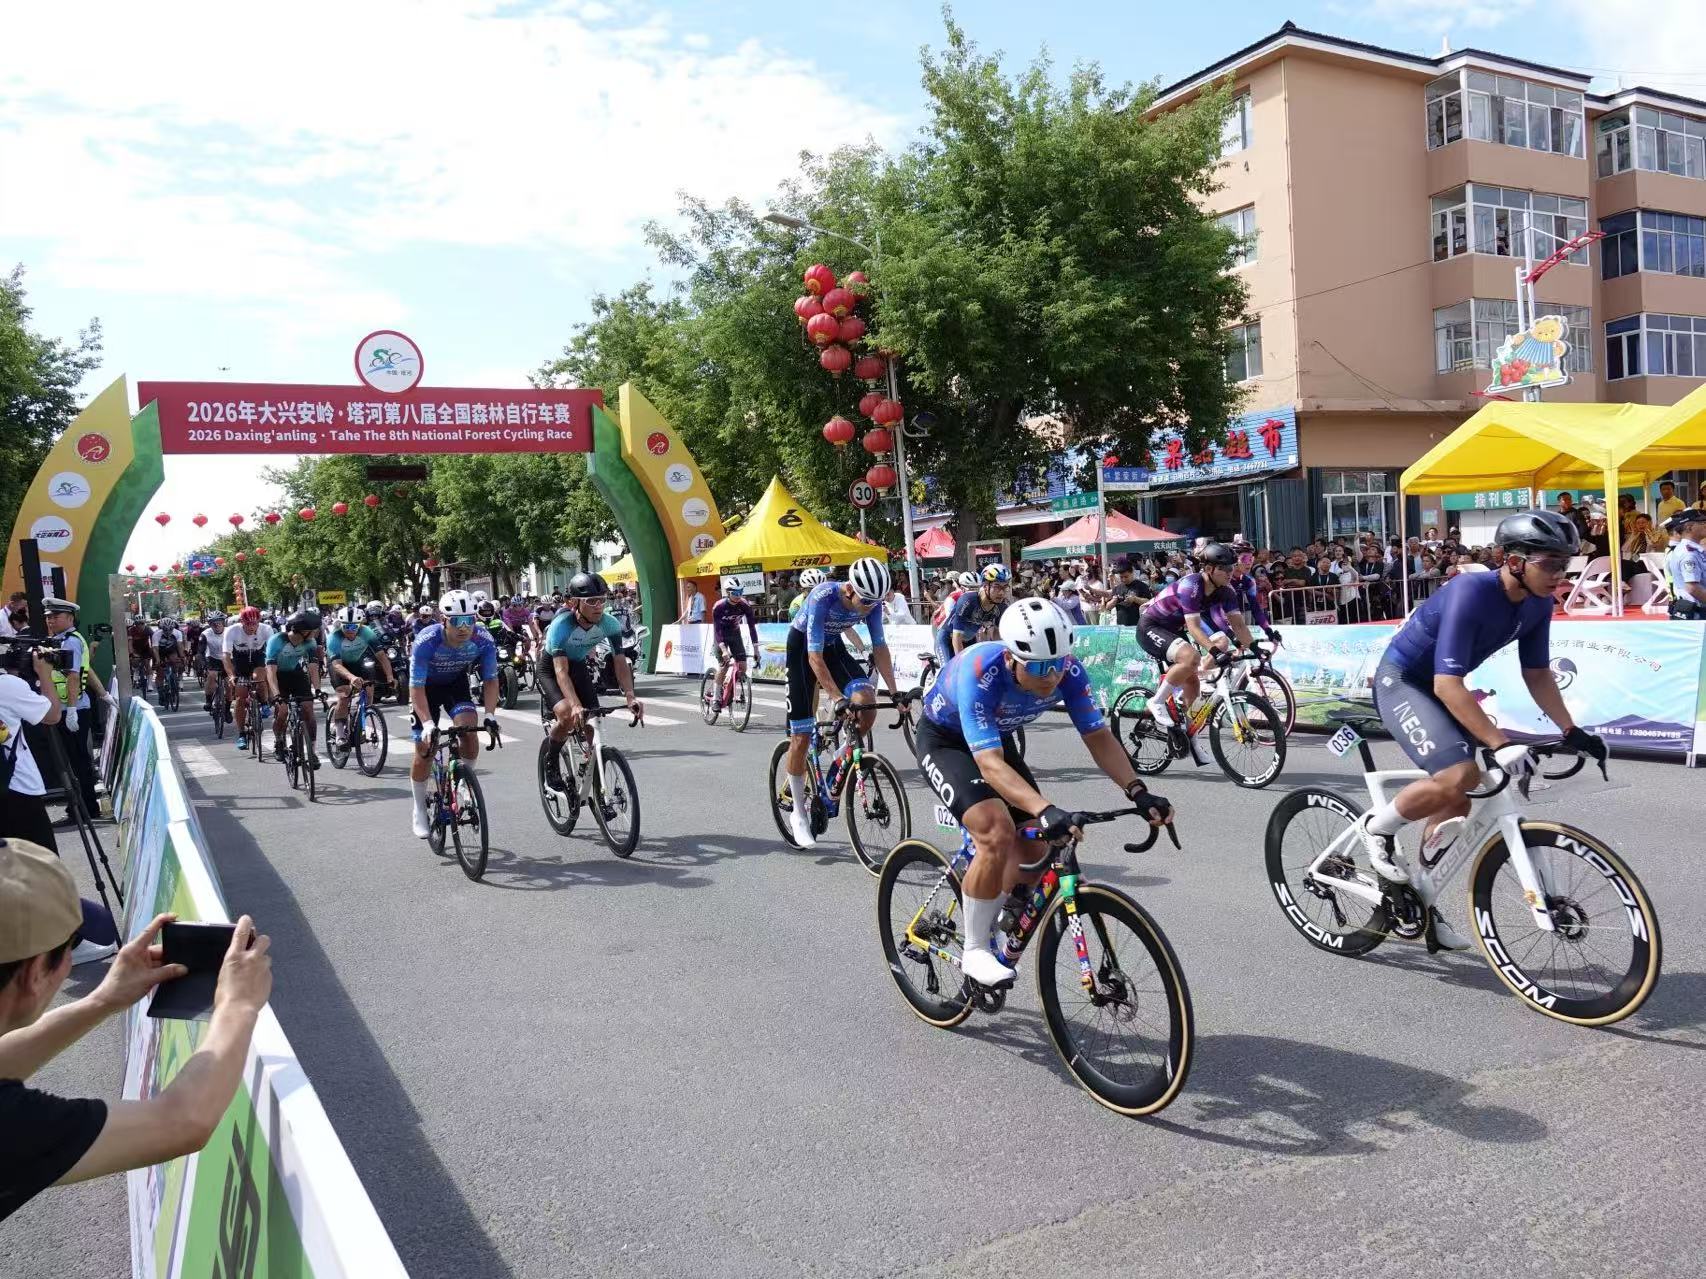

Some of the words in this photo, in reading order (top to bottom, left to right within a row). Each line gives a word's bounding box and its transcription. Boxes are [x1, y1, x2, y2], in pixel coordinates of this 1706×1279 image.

[187, 401, 571, 425] 2026年大兴安岭·塔河第八届全国森林自行车赛
[188, 429, 222, 441] 2026
[224, 429, 317, 444] Daxing'anling
[329, 430, 361, 441] Tahe
[363, 430, 386, 441] The
[389, 430, 410, 441] 8th
[412, 429, 462, 441] National
[465, 429, 501, 440] Forest
[503, 429, 545, 442] Cycling
[546, 429, 573, 439] Race
[856, 486, 872, 501] 30
[977, 665, 999, 691] MBO
[1331, 727, 1355, 753] 036
[1392, 701, 1436, 756] INEOS
[921, 754, 955, 808] MBO
[1243, 752, 1280, 785] SCOM
[1307, 794, 1359, 823] COM
[1555, 834, 1649, 943] SCOM
[1274, 882, 1344, 949] SCOM
[1475, 907, 1557, 1009] SCOM
